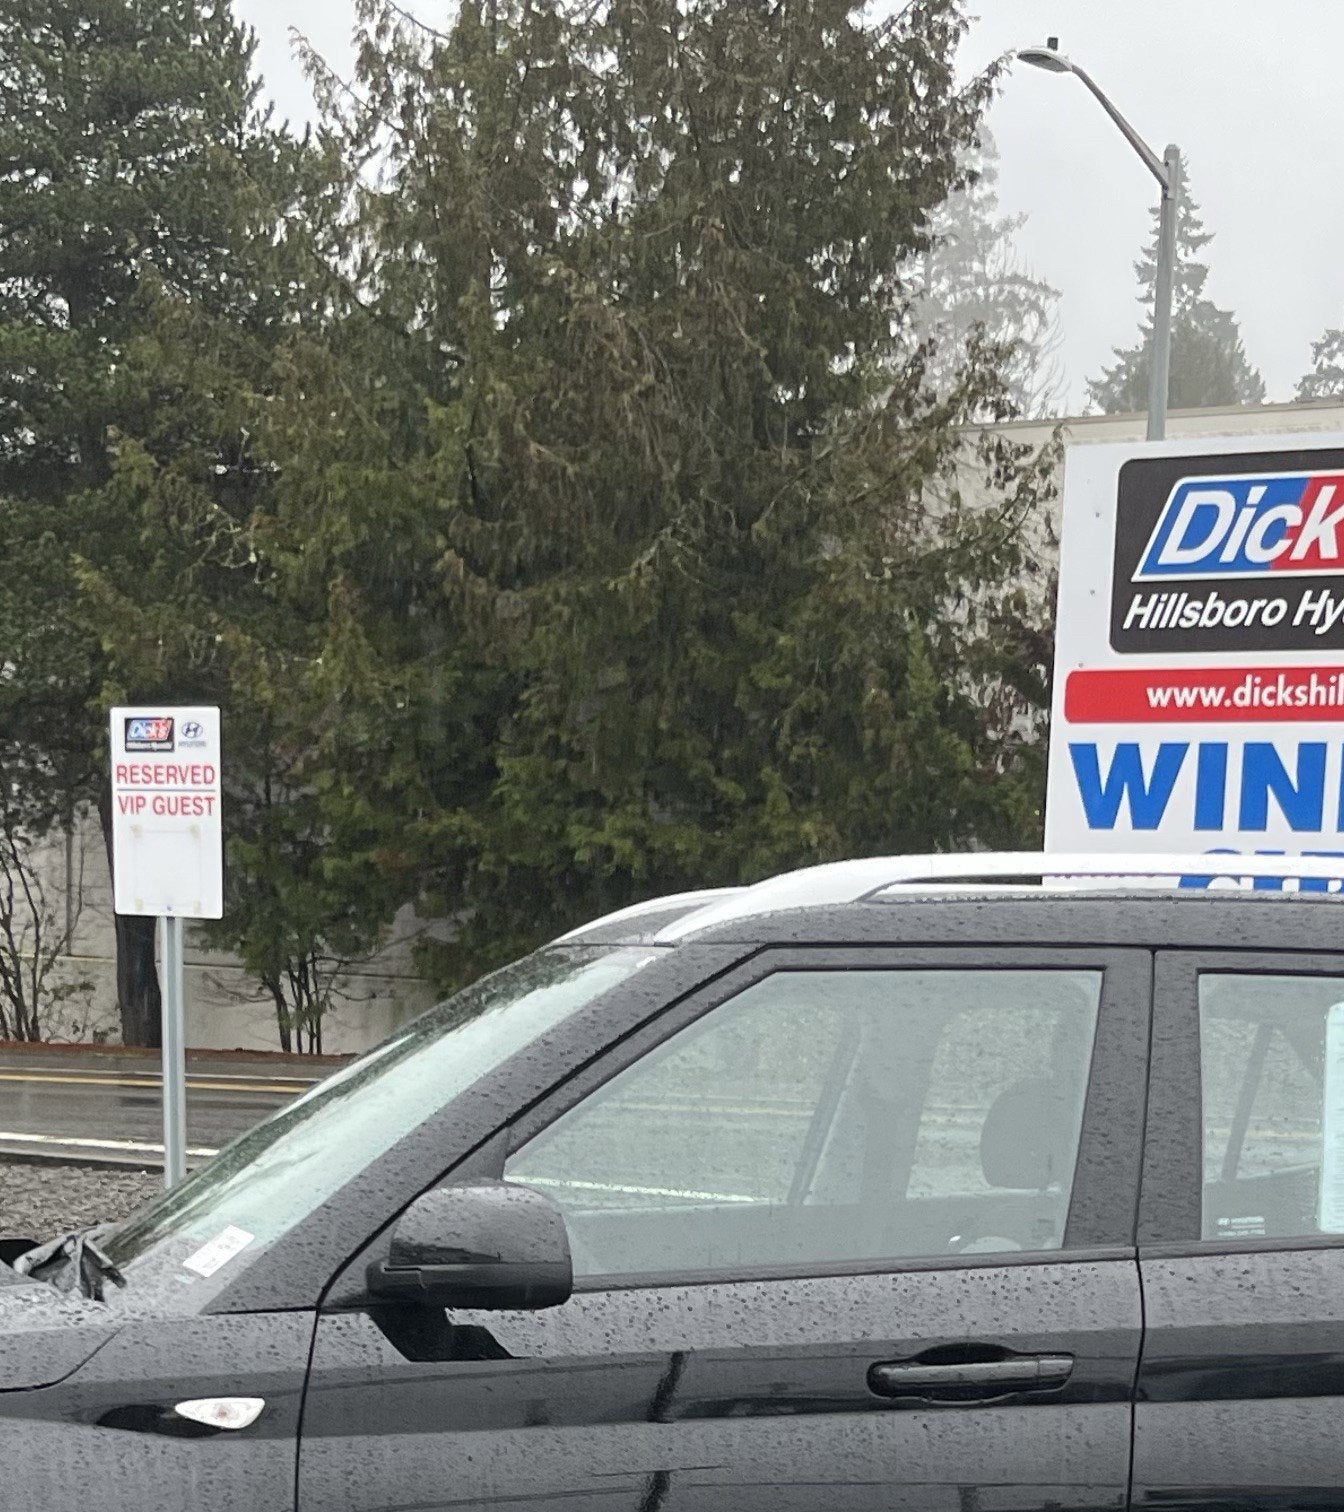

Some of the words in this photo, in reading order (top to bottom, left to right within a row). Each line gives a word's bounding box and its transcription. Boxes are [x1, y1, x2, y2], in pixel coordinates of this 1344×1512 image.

[1122, 591, 1287, 630] Hillsboro
[116, 764, 215, 785] RESERVED
[117, 796, 146, 814] VIP
[152, 796, 215, 816] GUEST
